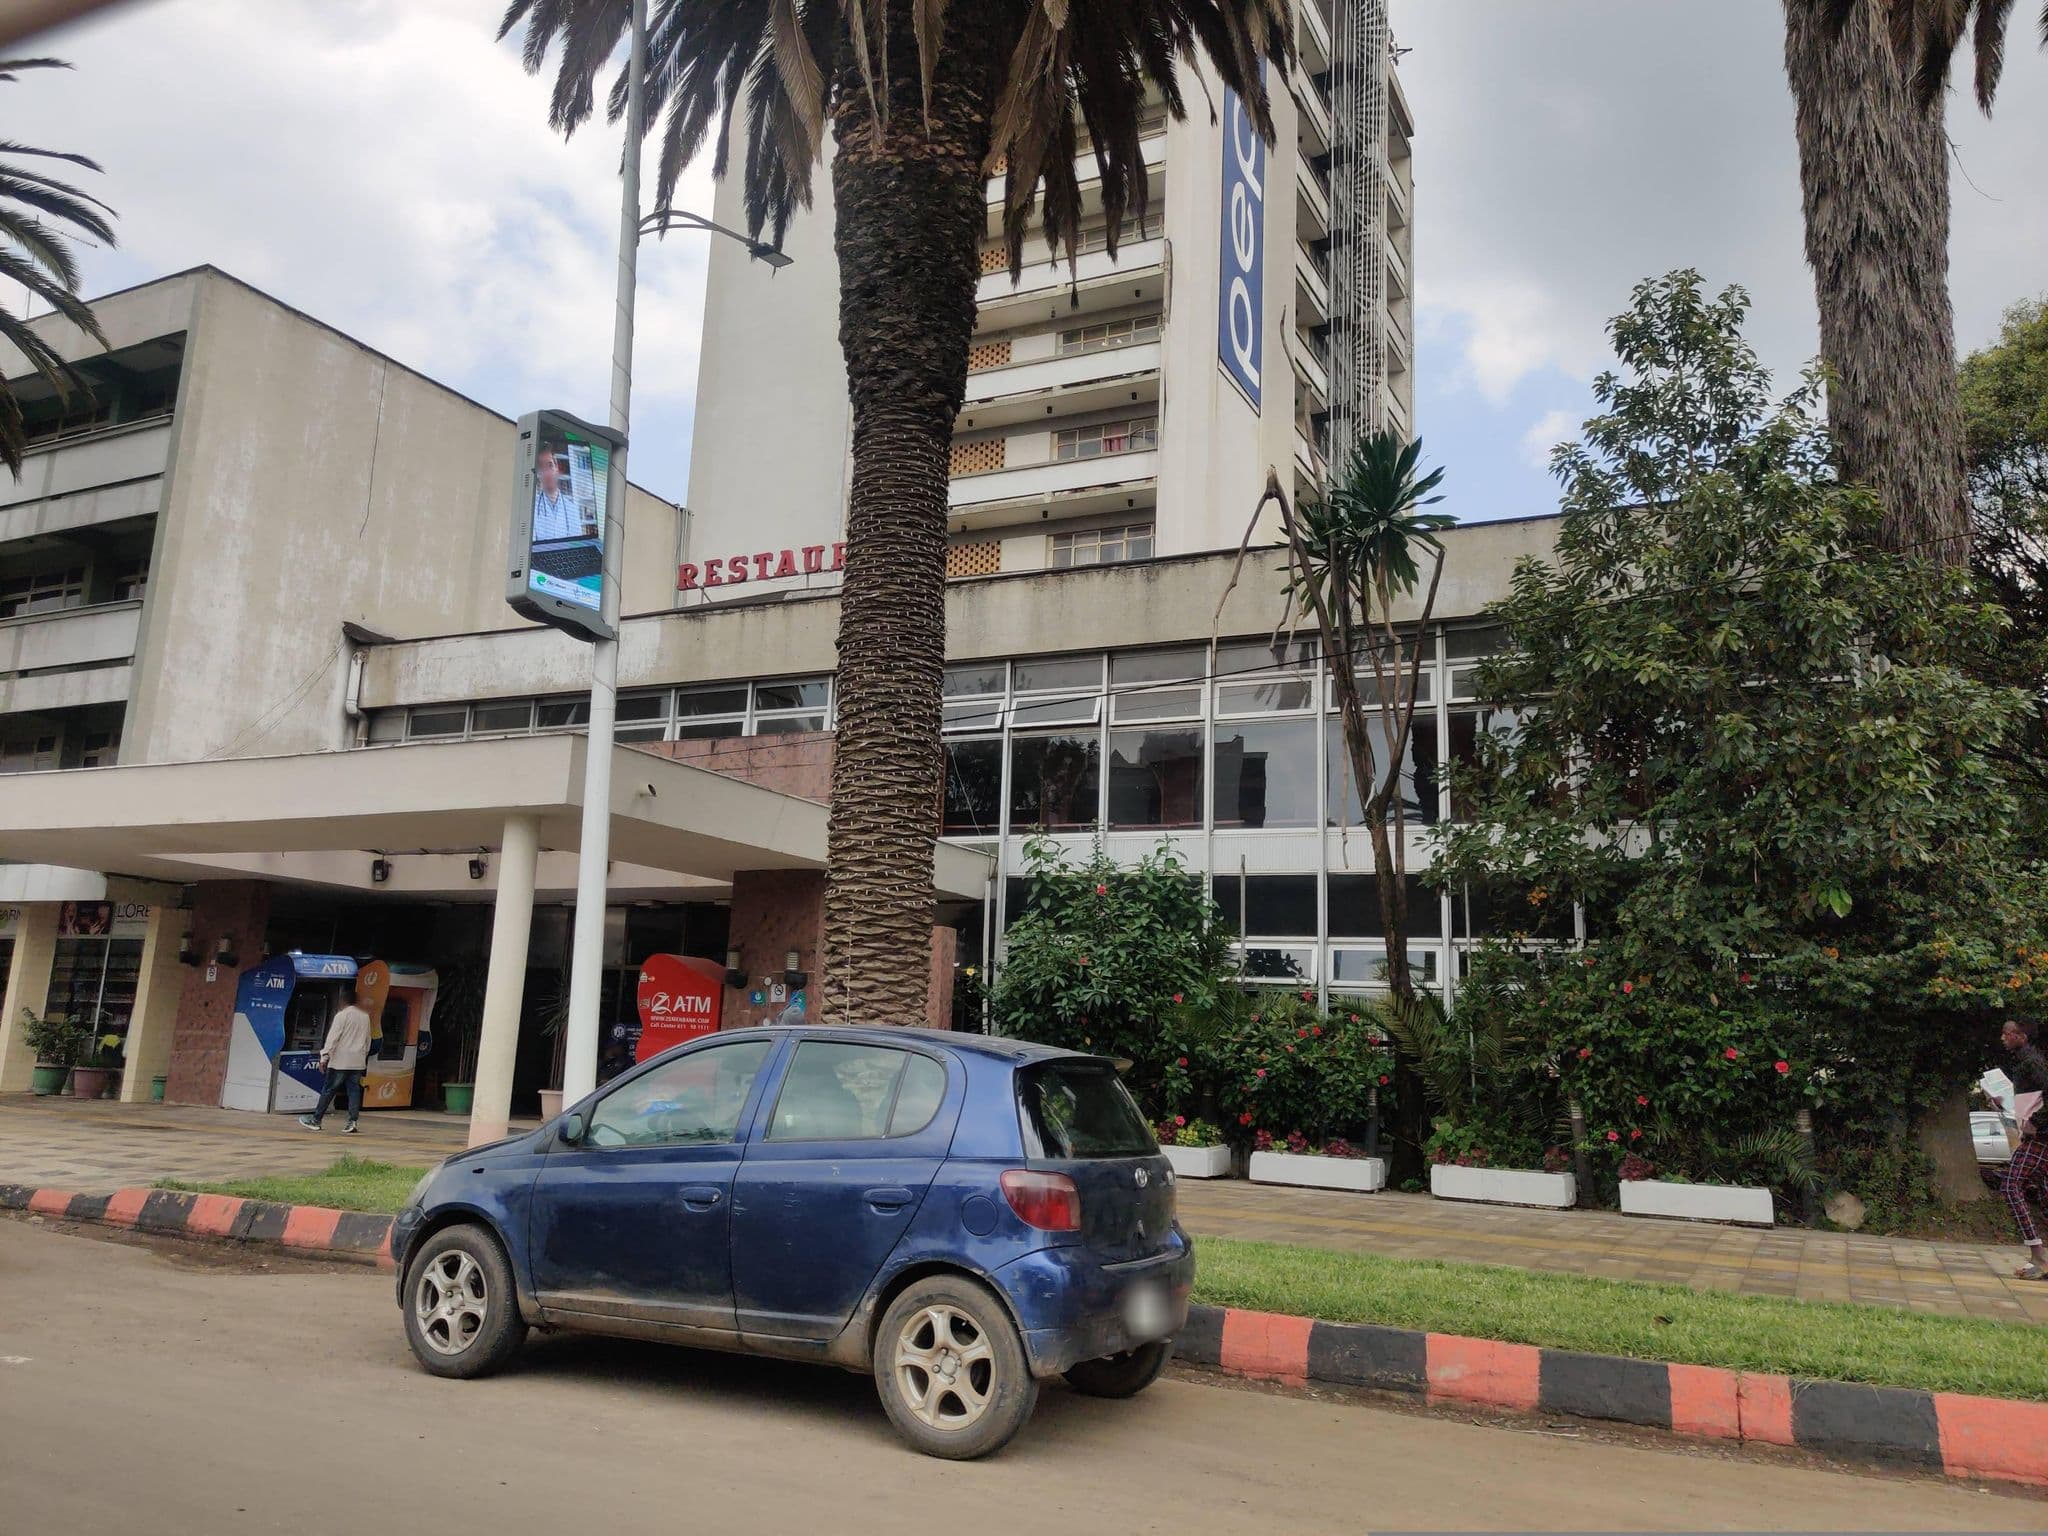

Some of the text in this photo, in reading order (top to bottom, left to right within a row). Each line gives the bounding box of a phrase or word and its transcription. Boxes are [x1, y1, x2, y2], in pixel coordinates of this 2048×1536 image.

[321, 963, 350, 975] ATM
[265, 978, 285, 989] ATM
[673, 995, 711, 1013] ATM
